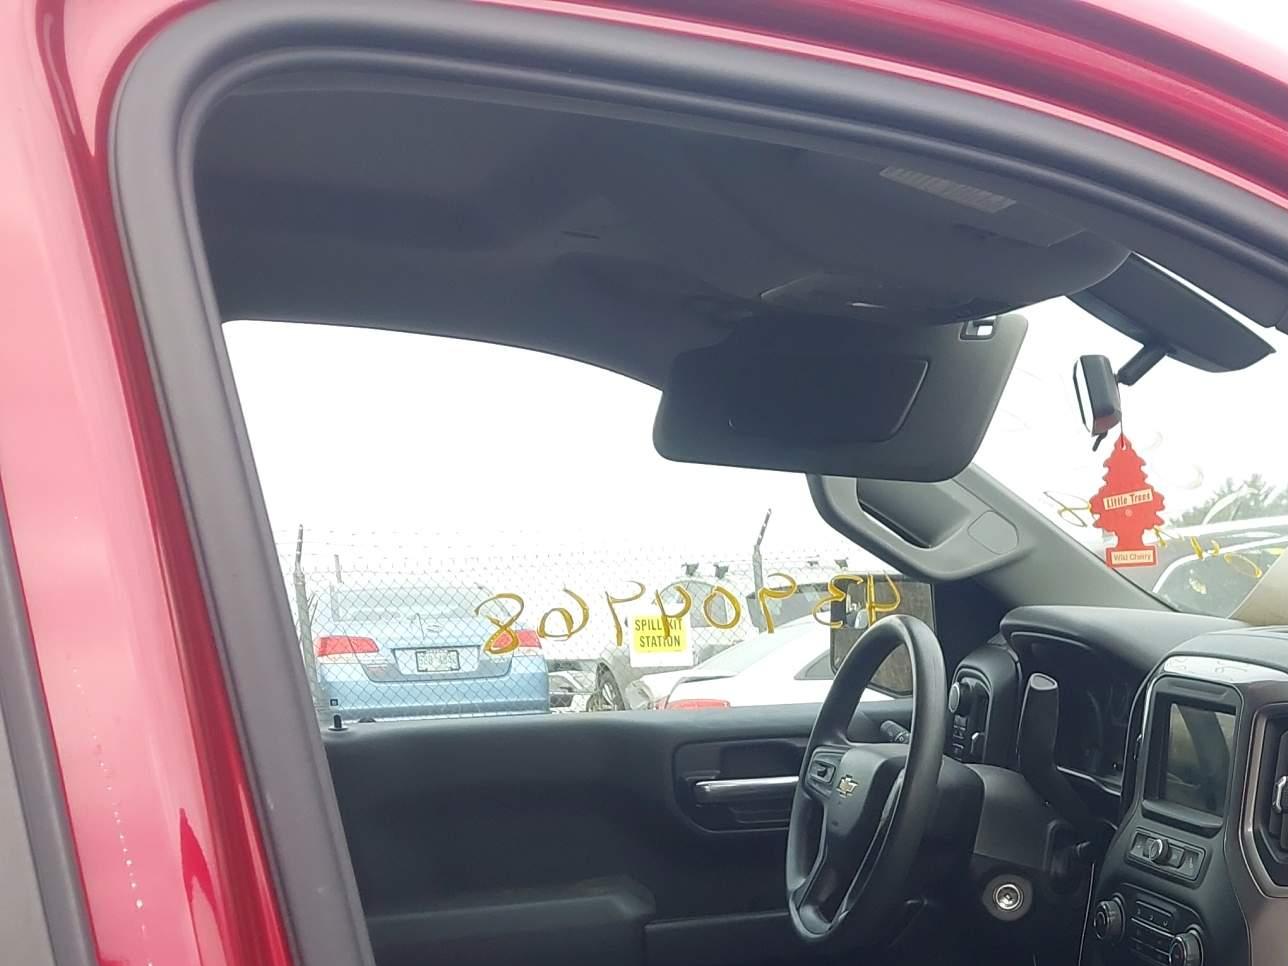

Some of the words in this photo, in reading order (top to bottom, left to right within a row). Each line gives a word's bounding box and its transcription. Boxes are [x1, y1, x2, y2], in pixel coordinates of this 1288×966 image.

[1106, 496, 1128, 508] Little
[1129, 492, 1151, 502] Trees
[634, 619, 662, 631] SPILL
[667, 618, 682, 631] KIT
[639, 635, 681, 648] STATION
